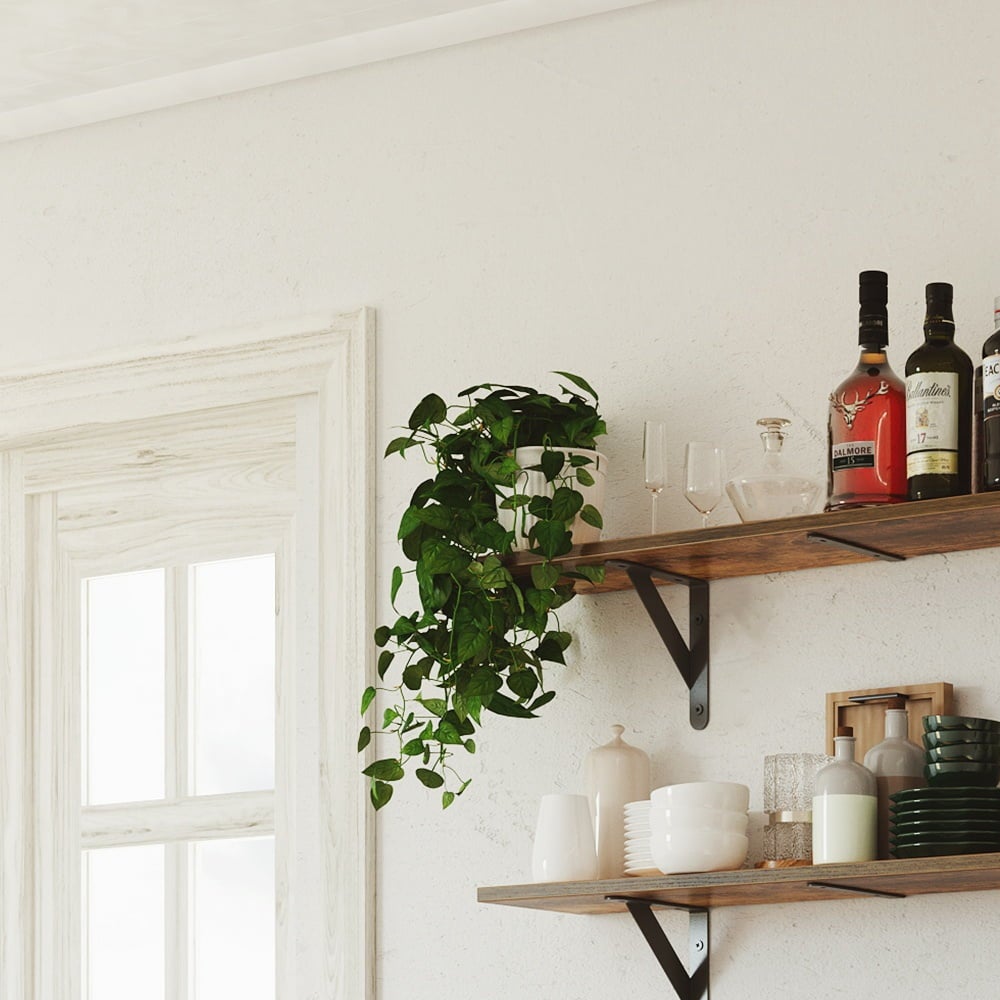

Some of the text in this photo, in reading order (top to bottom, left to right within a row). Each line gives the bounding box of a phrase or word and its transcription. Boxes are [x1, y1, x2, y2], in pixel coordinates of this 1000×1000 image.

[917, 433, 926, 446] 17
[834, 446, 873, 457] DALMORE
[847, 457, 855, 465] 15
